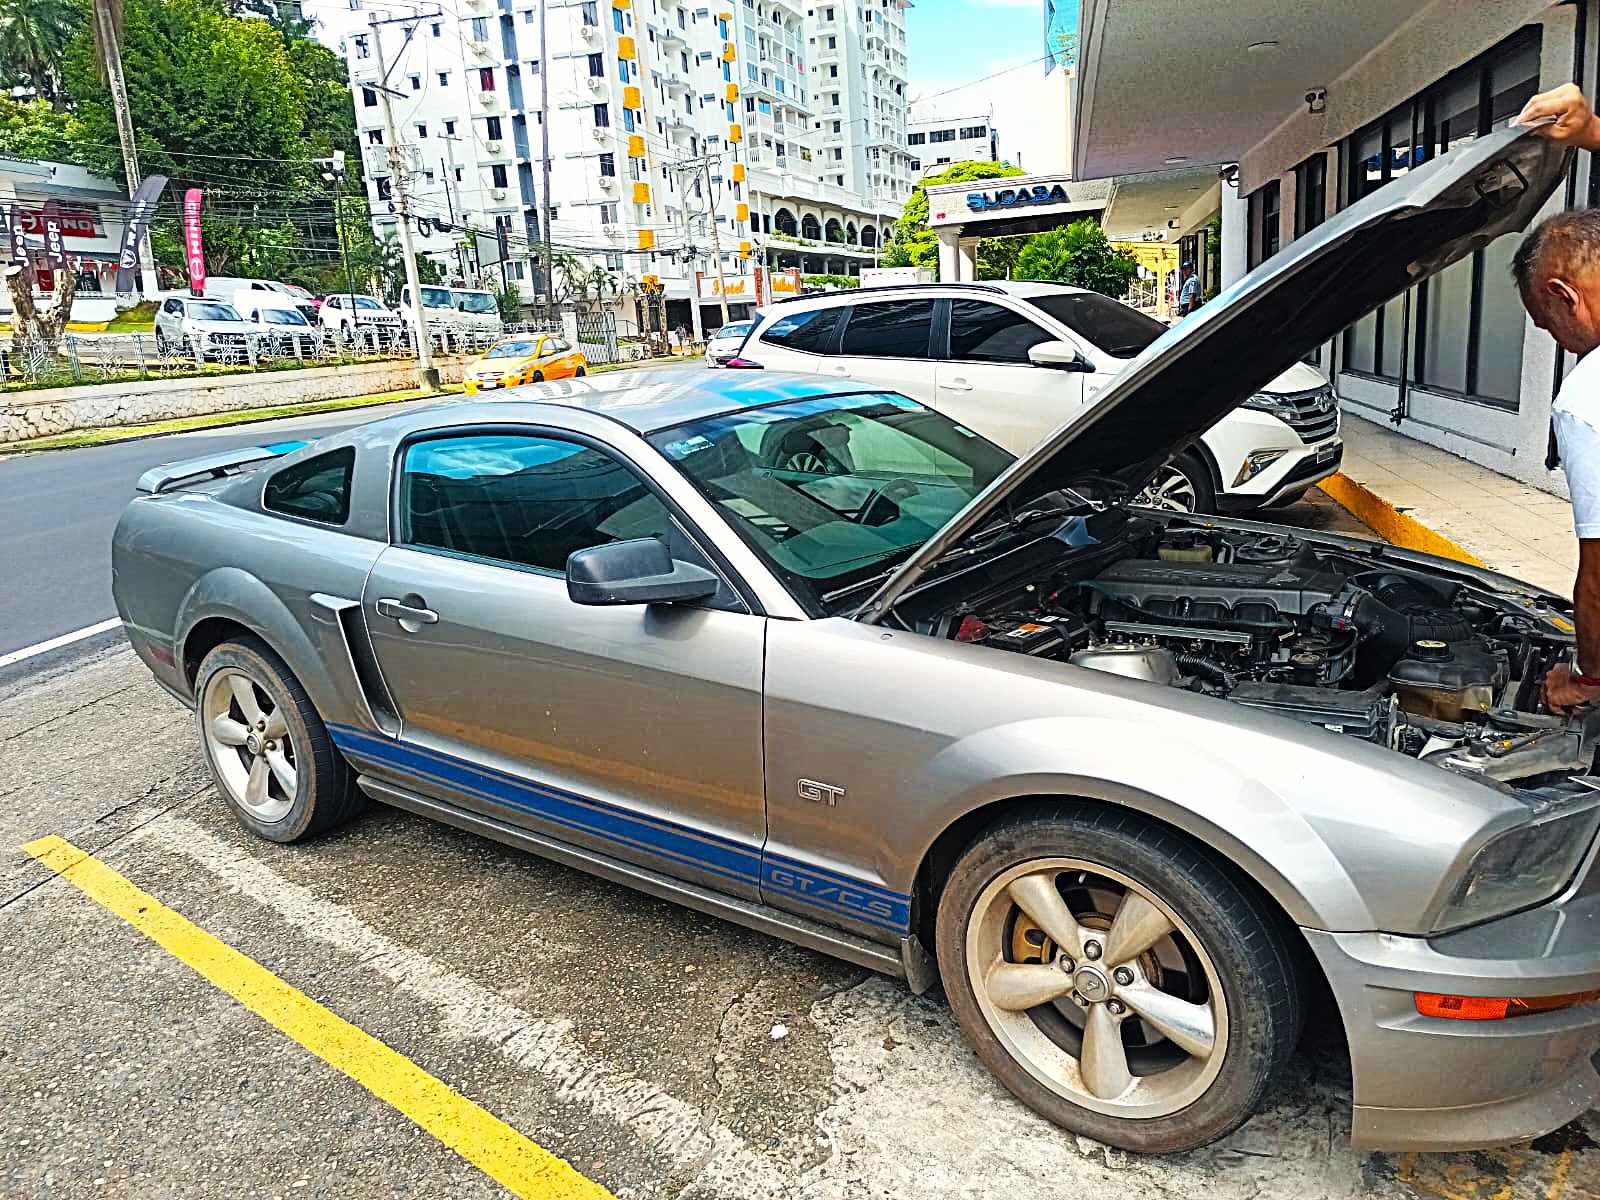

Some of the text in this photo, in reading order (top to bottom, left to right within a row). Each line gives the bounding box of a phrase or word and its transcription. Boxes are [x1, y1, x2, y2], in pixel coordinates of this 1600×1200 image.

[967, 184, 1068, 209] SUCASA
[13, 223, 30, 267] Jeep
[48, 220, 63, 263] Jeep
[797, 778, 845, 807] GT
[771, 870, 893, 917] GT/CS
